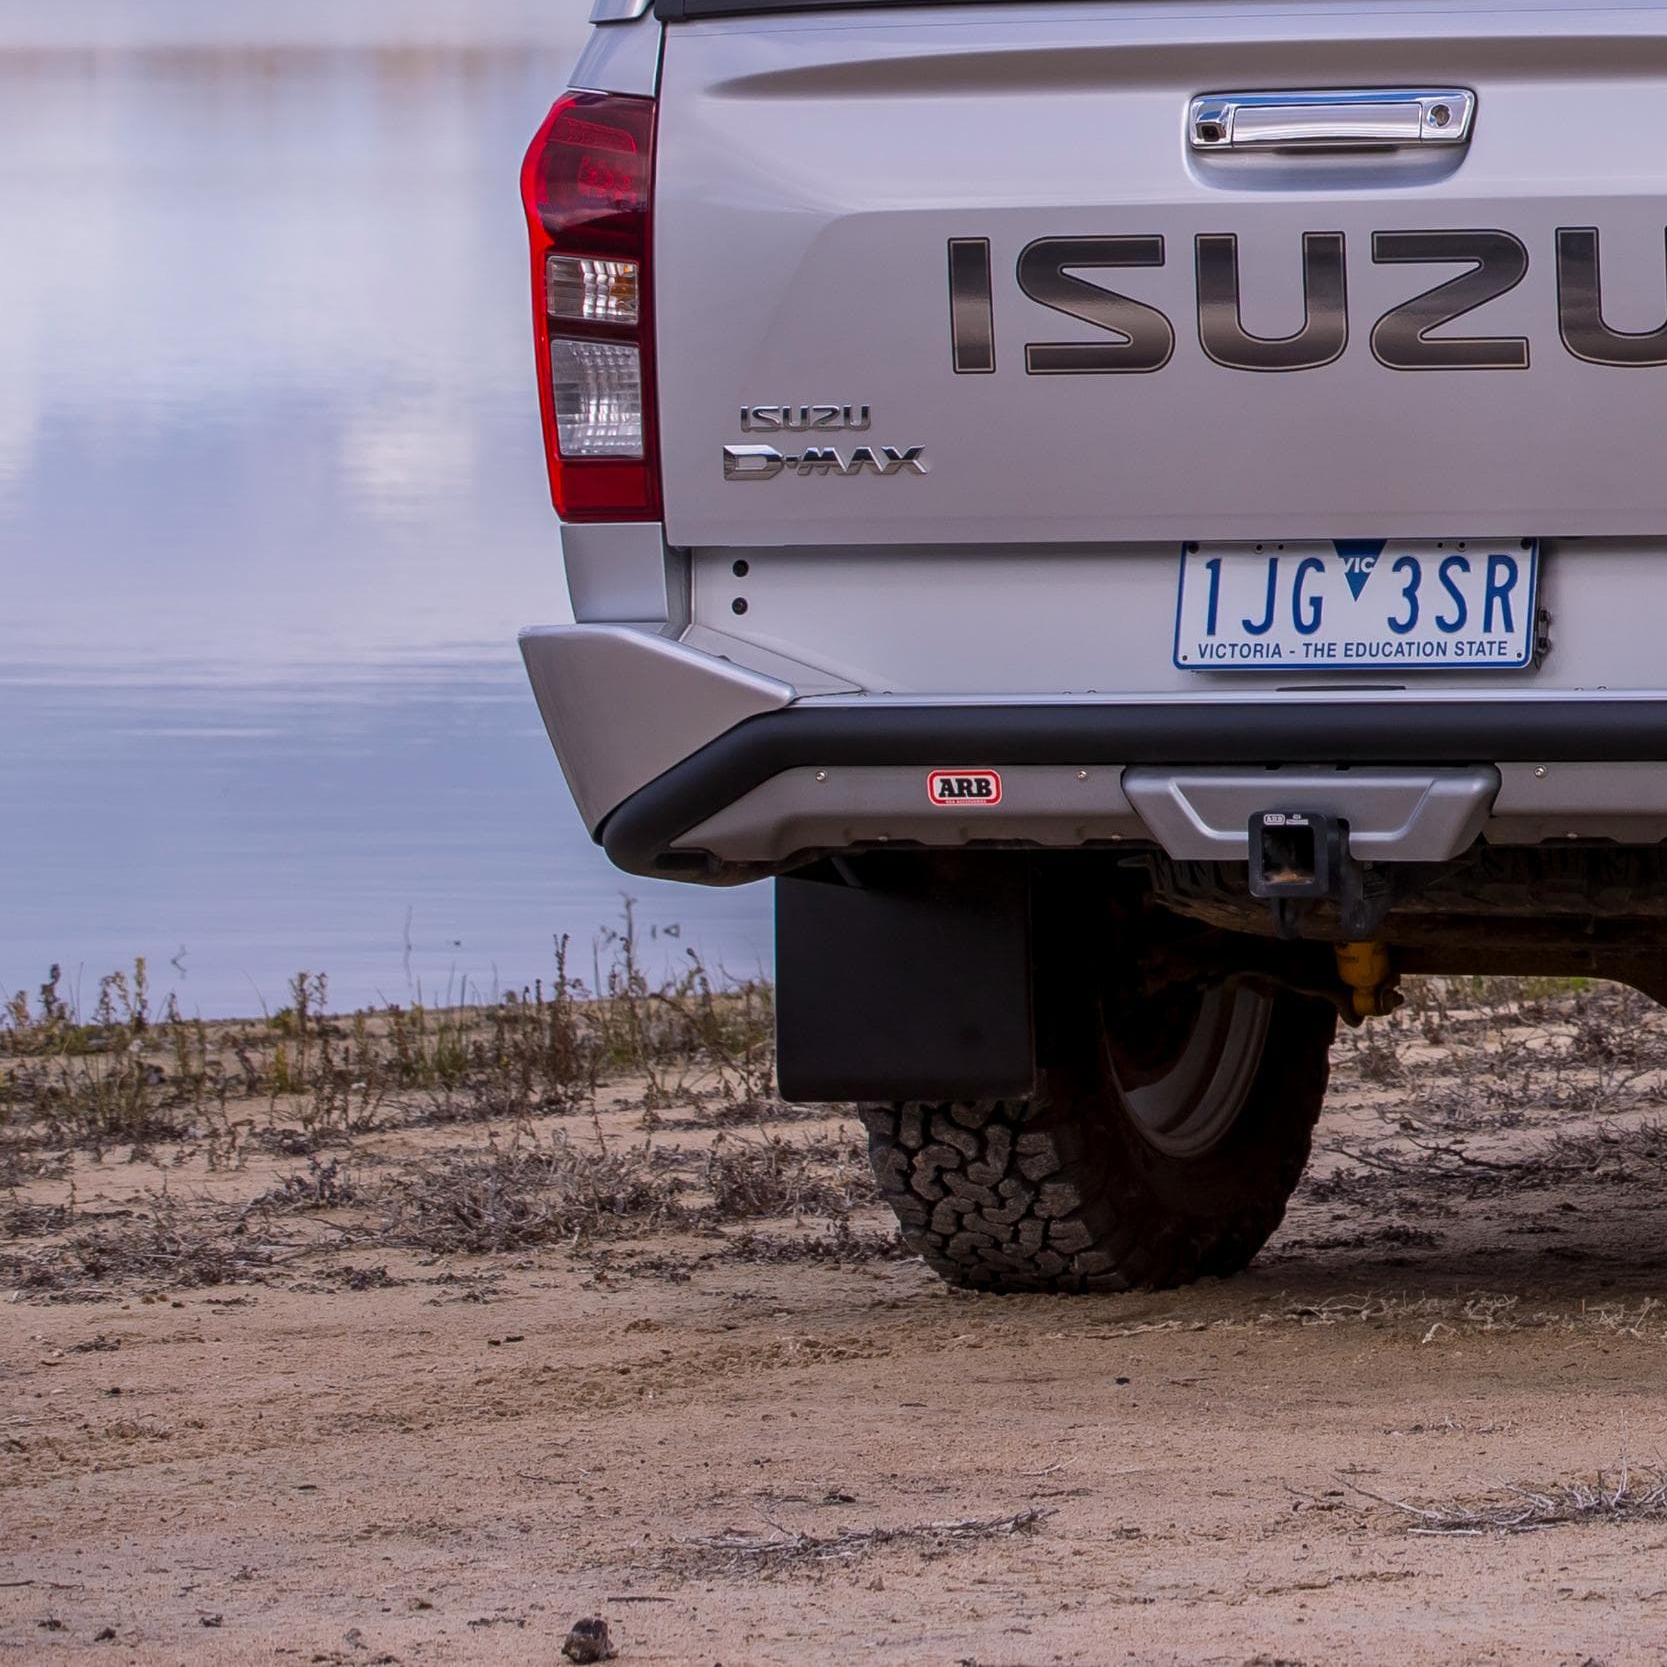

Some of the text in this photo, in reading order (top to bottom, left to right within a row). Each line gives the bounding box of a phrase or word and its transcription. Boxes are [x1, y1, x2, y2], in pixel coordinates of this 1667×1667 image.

[740, 404, 872, 432] ISUZU
[1342, 557, 1376, 573] VIC
[1198, 642, 1283, 659] VICTORIA
[1302, 642, 1338, 658] THE
[1344, 641, 1448, 657] EDUCATION
[1454, 640, 1508, 657] STATE
[938, 778, 993, 799] ARB
